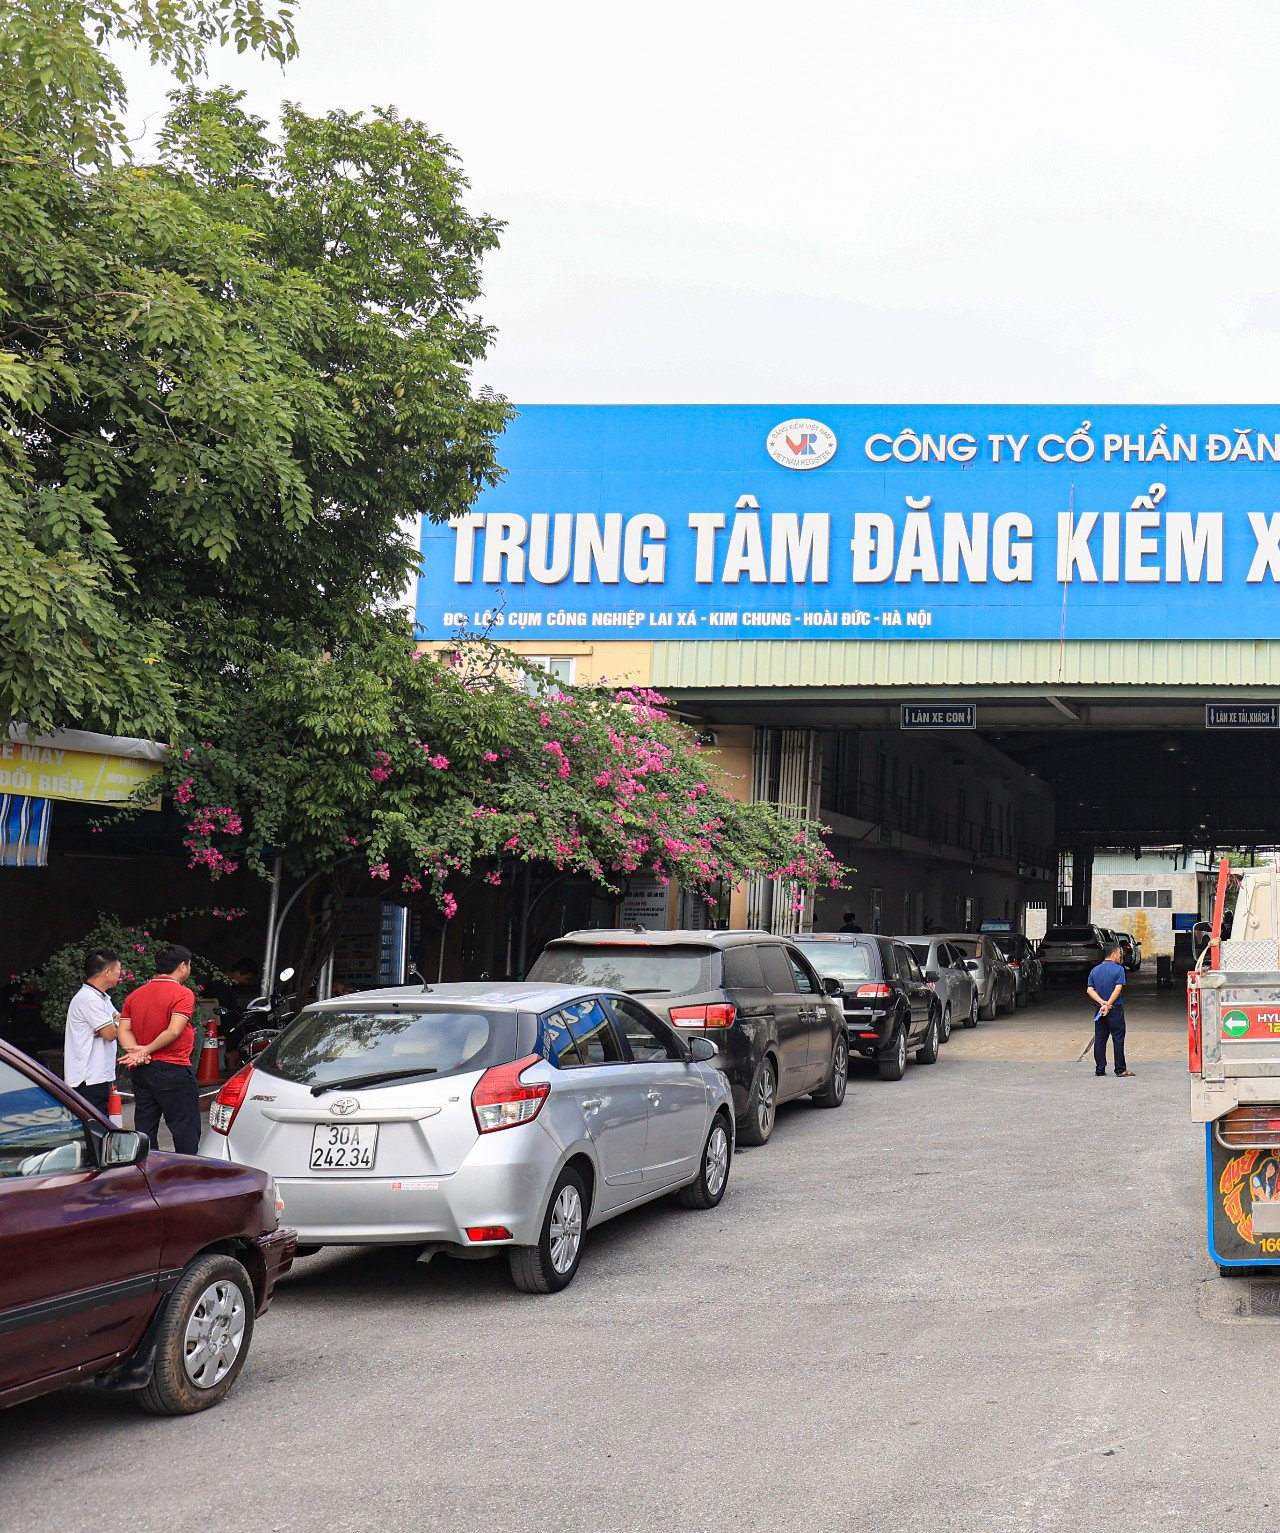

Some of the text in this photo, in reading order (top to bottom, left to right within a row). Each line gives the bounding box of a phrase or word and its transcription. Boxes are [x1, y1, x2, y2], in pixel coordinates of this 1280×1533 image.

[865, 427, 978, 463] CÔNG
[987, 434, 1033, 462] TY
[1037, 419, 1095, 463] CỔ
[1104, 423, 1197, 462] PHẦN
[449, 512, 667, 584] TRUNG
[688, 494, 830, 584] TÂM
[850, 495, 1034, 584] ĐĂNG
[1056, 482, 1223, 583] KIỂM
[474, 609, 493, 626] LÔ
[508, 612, 542, 629] CỤM
[546, 609, 586, 626] CÔNG
[592, 609, 646, 628] NGHIỆP
[649, 612, 673, 626] LAI
[677, 609, 697, 626] XÁ
[709, 612, 738, 626] KIM
[742, 612, 791, 626] CHUNG
[803, 609, 838, 626] HOÀI
[841, 609, 871, 626] ĐỨC
[882, 609, 902, 626] HÀ
[906, 609, 932, 628] NỘI
[911, 709, 965, 723] LÀN XE CON
[1216, 710, 1228, 723] LÀN
[1229, 712, 1237, 723] XE
[0, 742, 14, 760] E
[328, 1126, 361, 1146] 30A
[312, 1147, 371, 1167] 242.34
